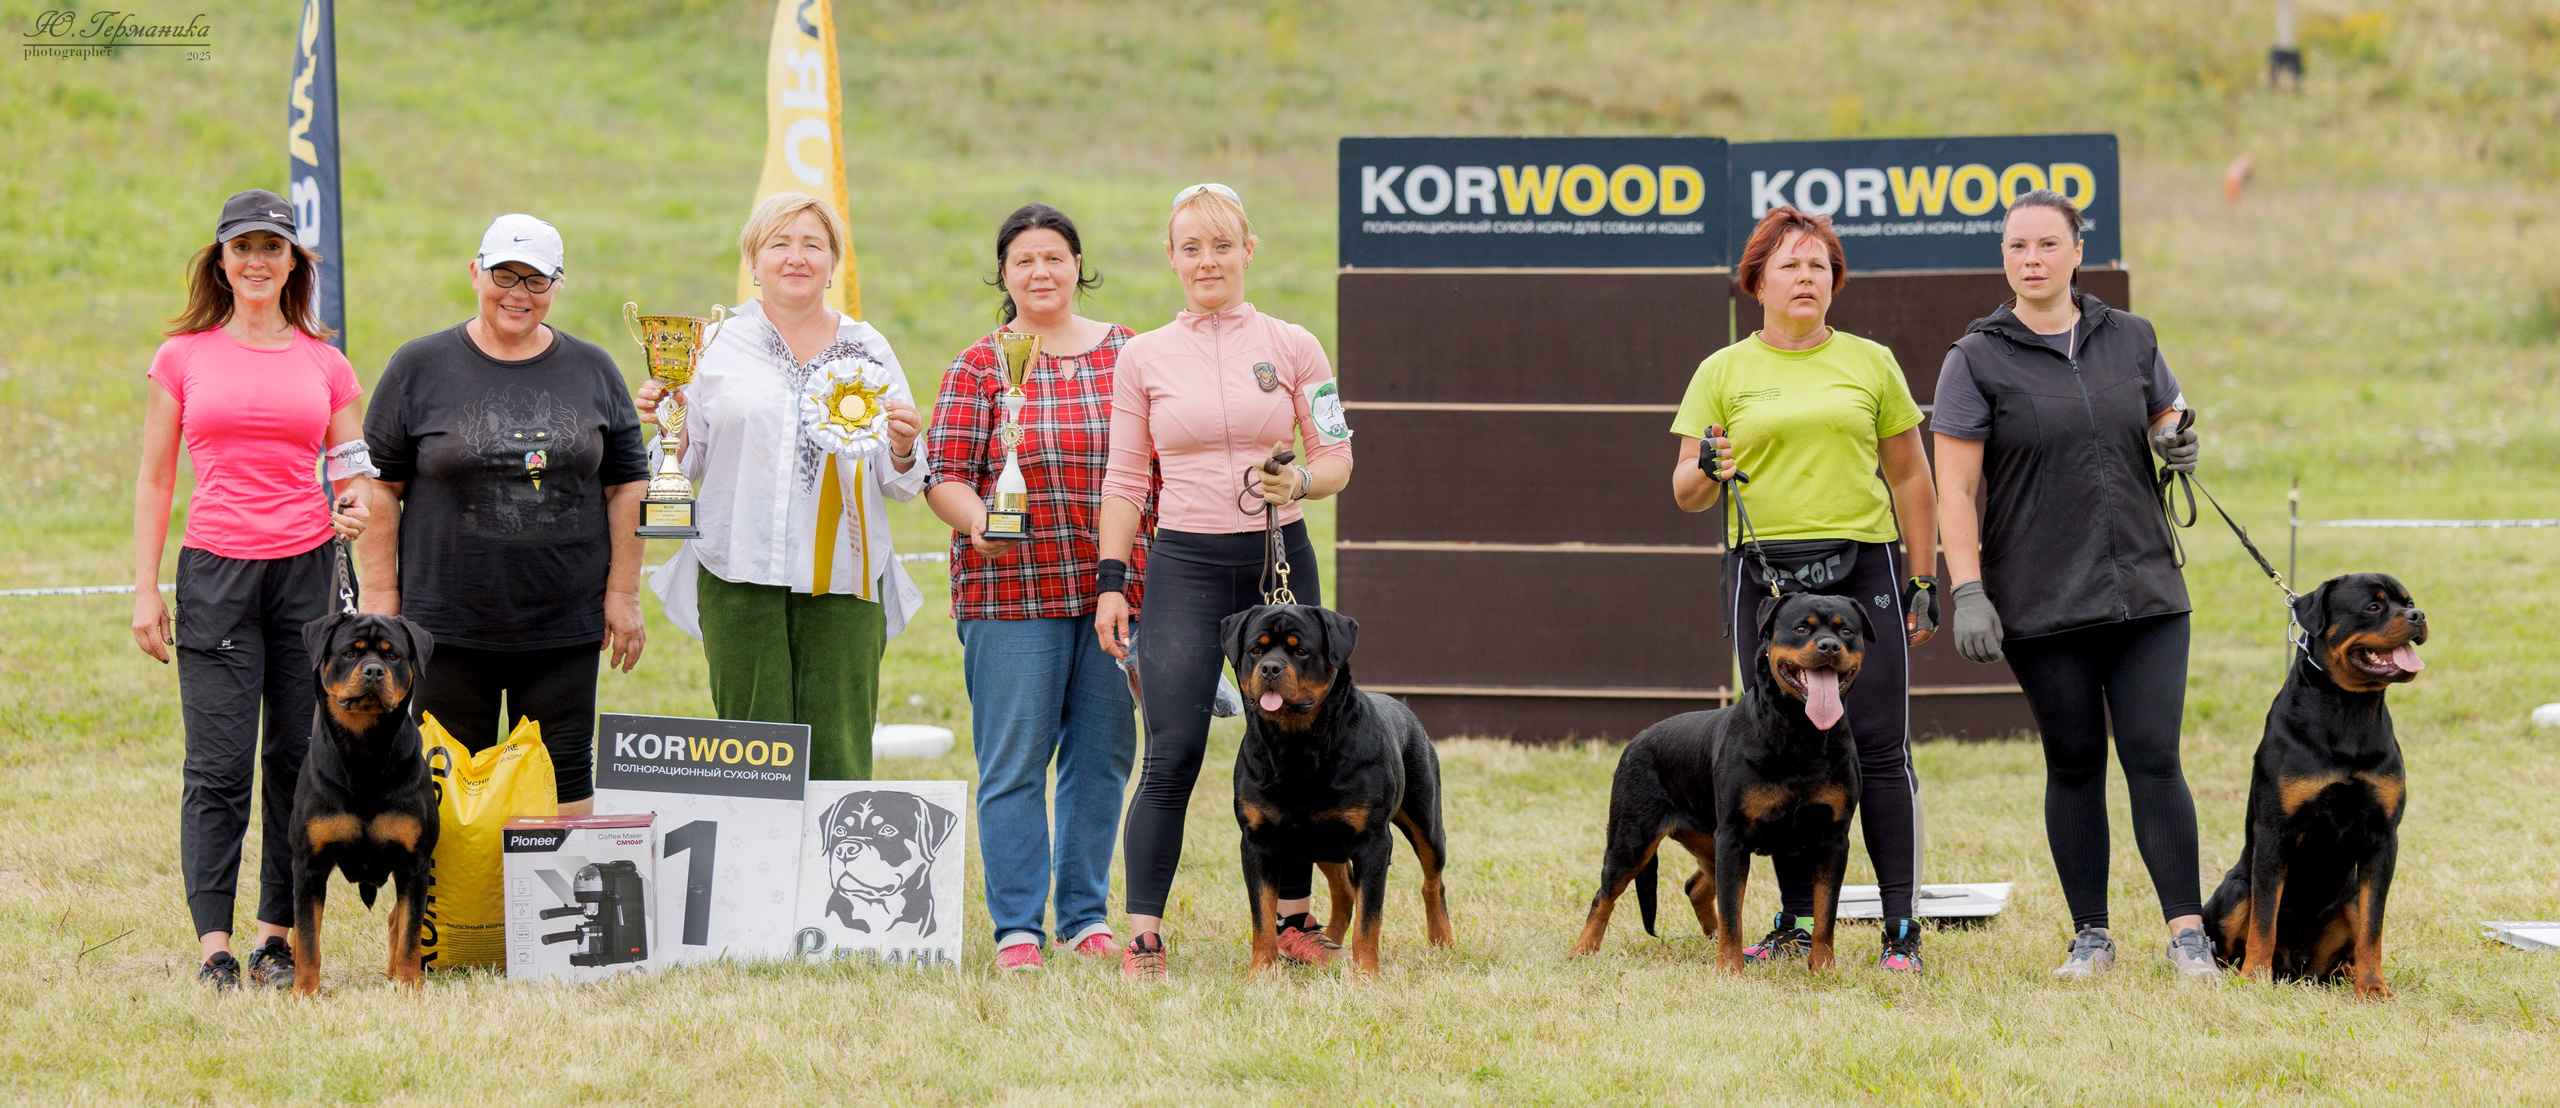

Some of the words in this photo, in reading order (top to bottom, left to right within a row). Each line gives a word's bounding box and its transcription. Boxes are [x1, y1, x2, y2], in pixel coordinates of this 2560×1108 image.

[1361, 164, 1705, 216] KORWOOD
[1751, 162, 2095, 219] KORWOOD
[1492, 219, 1534, 234] СУХОЙ
[1535, 221, 1573, 234] КОРМ
[1573, 221, 1600, 235] ДЛЯ
[1601, 221, 1644, 234] СОБАК
[1645, 221, 1657, 234] И
[1657, 221, 1705, 234] КОШЕК
[614, 732, 794, 767] KORWOOD
[613, 763, 721, 778] ПОЛНОРАЦИОННЫЙ
[723, 768, 759, 780] СУХОЙ
[761, 772, 791, 782] КОРМ
[510, 836, 558, 847] Pioneer
[622, 832, 643, 840] Maker
[663, 820, 718, 947] 1
